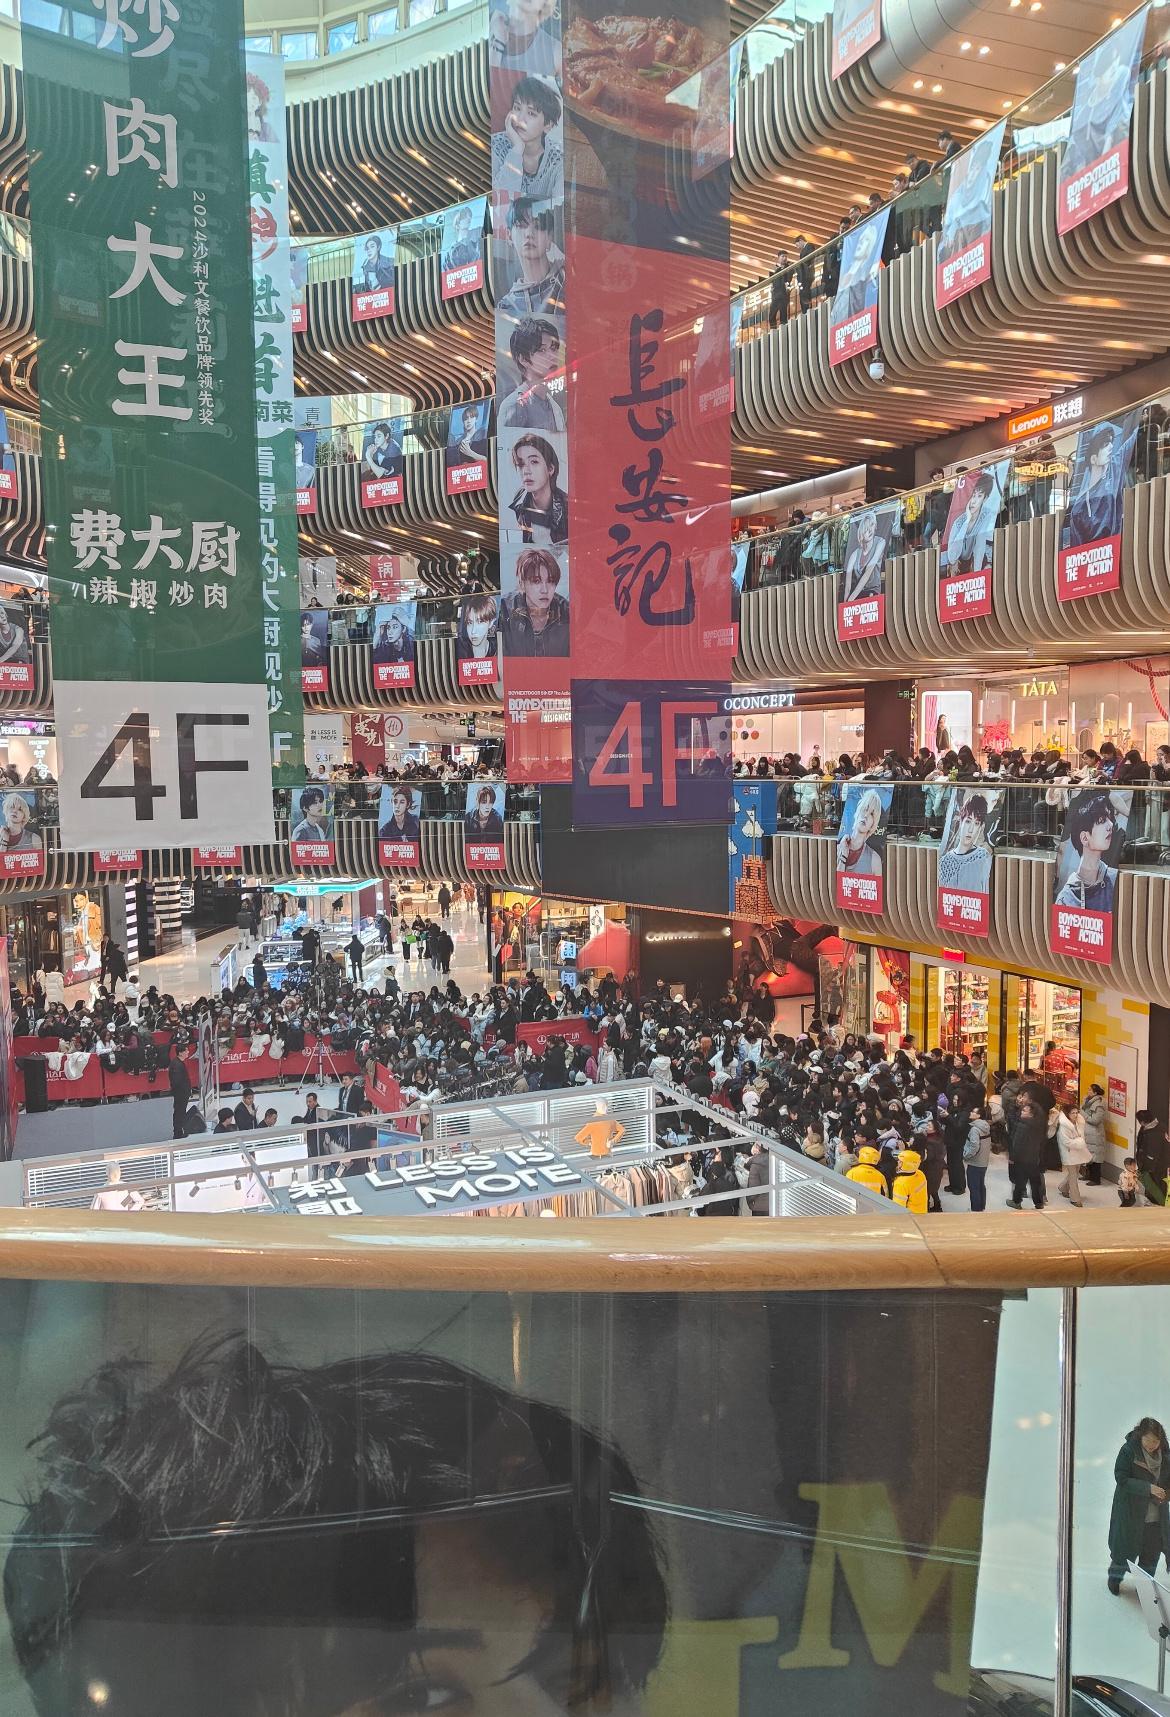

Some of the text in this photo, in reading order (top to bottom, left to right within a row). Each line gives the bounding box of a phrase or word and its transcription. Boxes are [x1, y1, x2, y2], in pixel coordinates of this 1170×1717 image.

[1067, 152, 1120, 199] BOYNEXTDOOR
[1067, 165, 1121, 213] THE ACTION
[95, 0, 193, 421] 炒肉大王
[943, 242, 985, 280] BOYNEXTDOOR
[943, 256, 985, 291] THE ACTION
[192, 190, 216, 427] 2024沙利文餐饮品牌领先奖
[835, 312, 872, 340] BOYNEXTDOOR
[835, 323, 872, 351] THE ACTION
[1053, 396, 1083, 423] 联想
[1012, 414, 1049, 434] Lenovo
[452, 465, 482, 477] BOYNEXTDOOR
[452, 473, 483, 485] THE ACTION
[366, 480, 398, 491] BOYNEXTDOOR
[367, 488, 398, 498] THE ACTION
[70, 509, 241, 577] 费大厨
[1066, 544, 1114, 570] BOYNEXTDOOR
[1065, 558, 1114, 583] THE ACTION
[89, 575, 228, 609] 辣椒炒肉
[945, 576, 986, 596] BOYNEXTDOOR
[945, 588, 986, 607] THE ACTION
[843, 601, 879, 617] BOYNEXTDOOR
[843, 611, 879, 627] THE ACTION
[0, 665, 28, 674] NEXTDOOR
[378, 665, 410, 675] BOYNEXTDOOR
[462, 660, 493, 670] BOYNEXTDOOR
[463, 667, 493, 677] THE ACTION
[393, 671, 410, 680] ACTION
[509, 711, 528, 724] THE
[589, 701, 718, 809] 4F
[81, 712, 250, 821] 4F
[296, 850, 329, 858] THE ACTION
[383, 844, 414, 852] BOYNEXTDOOR
[398, 851, 415, 859] ACTION
[469, 846, 500, 854] BOYNEXTDOOR
[4, 853, 39, 863] BOYNEXTDOOR
[5, 859, 39, 870] THE ACTION
[471, 853, 501, 861] THE ACTION
[842, 876, 878, 891] BOYNEXTDOOR
[843, 886, 878, 901] THE ACTION
[942, 893, 982, 910] BOYNEXTDOOR
[943, 904, 982, 922] THE ACTION
[1058, 911, 1104, 933] BOYNEXTDOOR
[1058, 924, 1104, 946] THE ACTION
[365, 1146, 555, 1192] LESS IS
